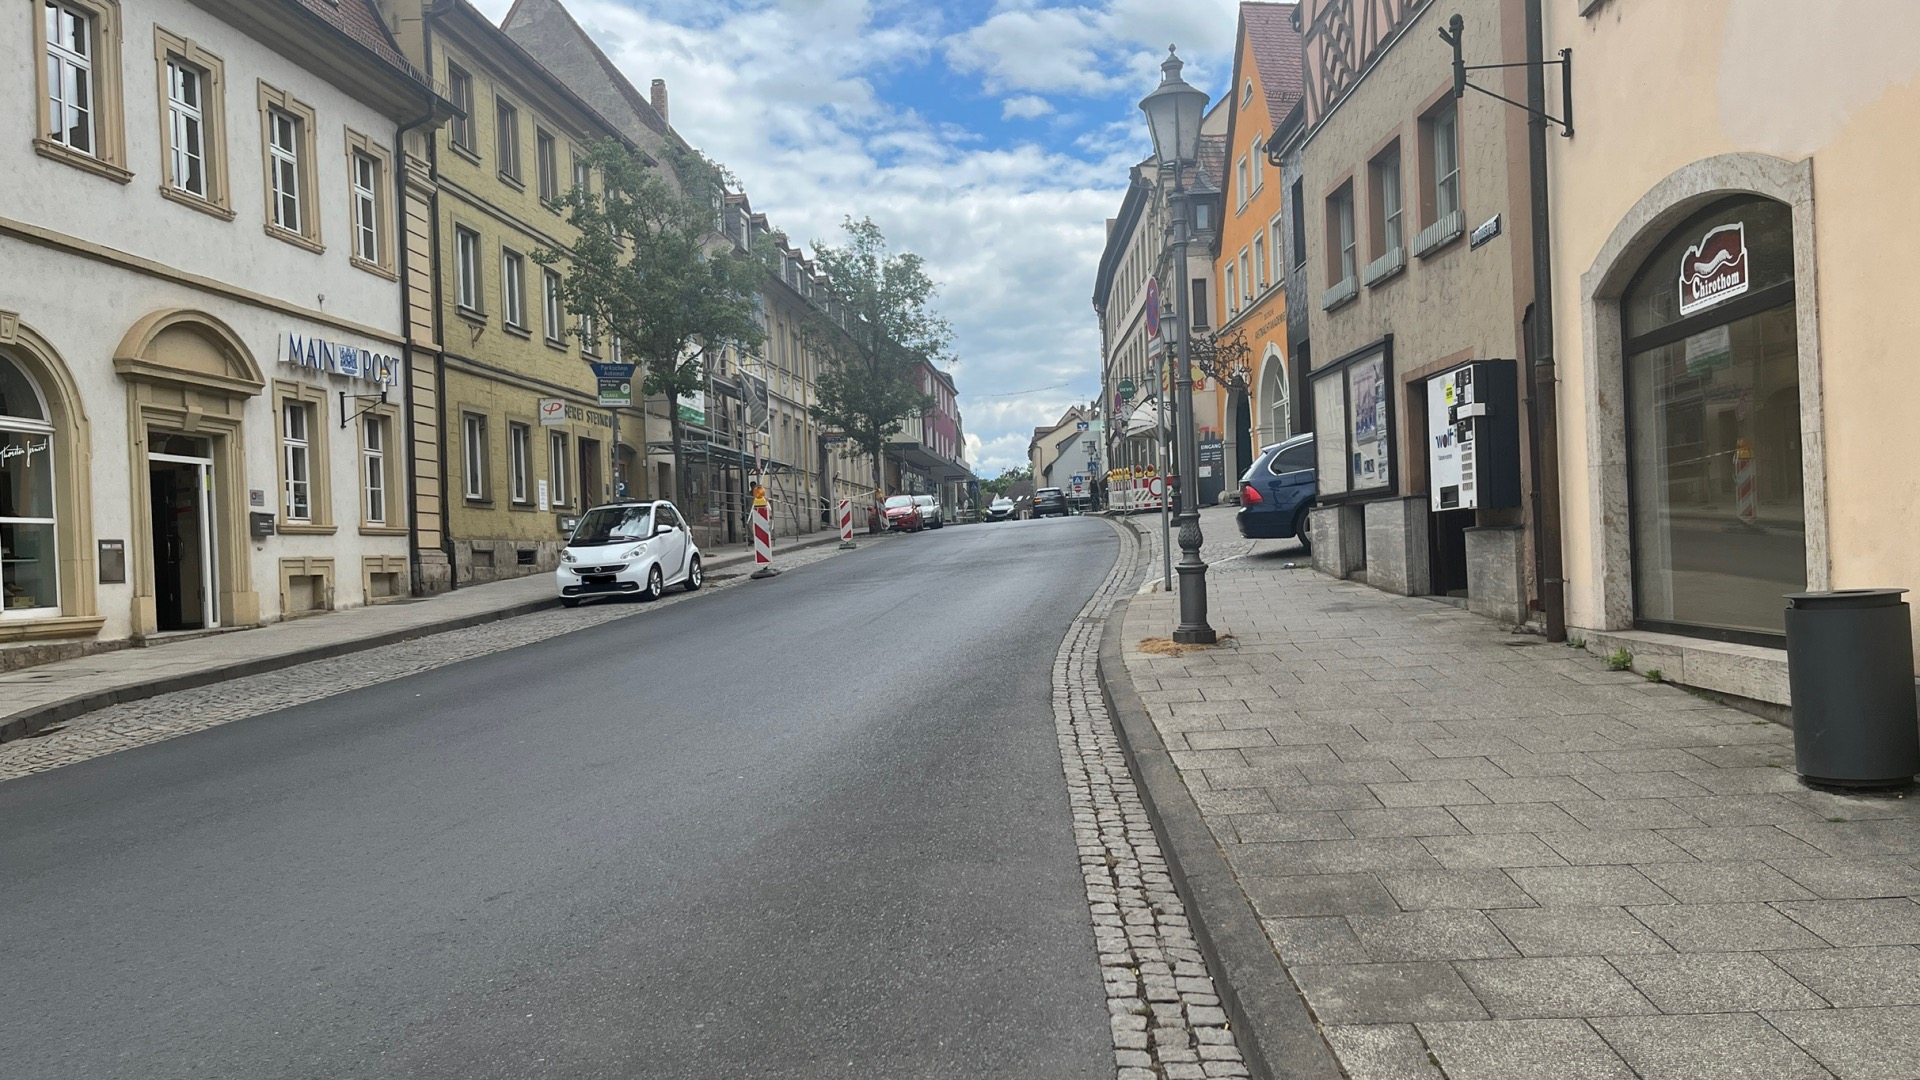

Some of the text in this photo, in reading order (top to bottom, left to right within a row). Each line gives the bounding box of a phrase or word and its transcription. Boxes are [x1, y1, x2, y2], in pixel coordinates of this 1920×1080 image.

[1692, 271, 1740, 299] Chirothom
[289, 330, 399, 386] MAIN POST
